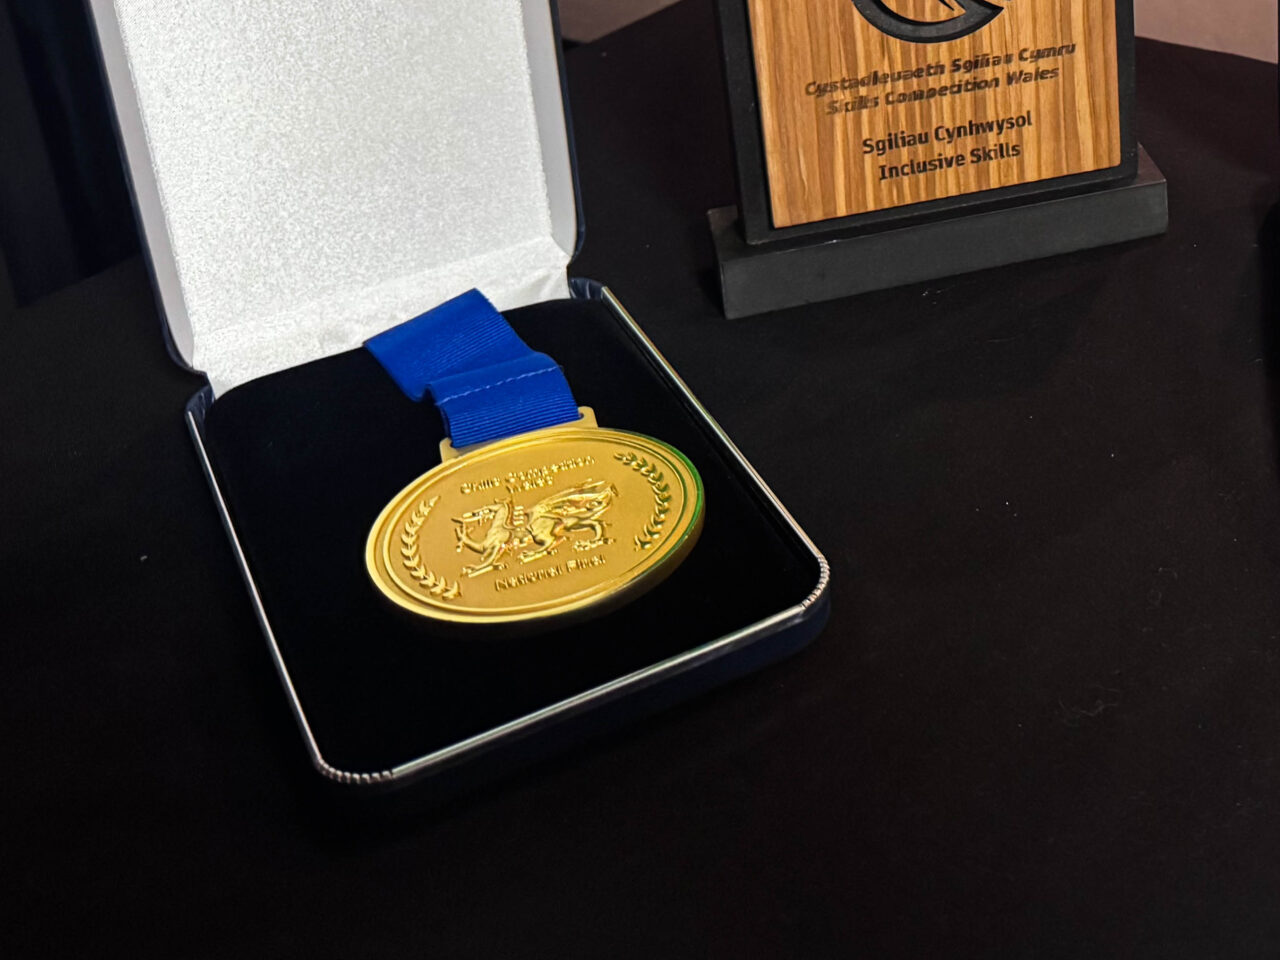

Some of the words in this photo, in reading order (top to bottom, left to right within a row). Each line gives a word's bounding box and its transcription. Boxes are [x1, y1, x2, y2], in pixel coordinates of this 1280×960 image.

[951, 52, 1014, 74] Sgiliau
[1018, 43, 1076, 62] Cymru
[825, 94, 879, 115] Skills
[885, 77, 999, 105] Competition
[1006, 66, 1060, 86] Wales
[862, 131, 929, 157] Sgiliau
[934, 111, 1032, 143] Cynhwysol
[879, 152, 965, 180] Inclusive
[970, 141, 1021, 164] Skills
